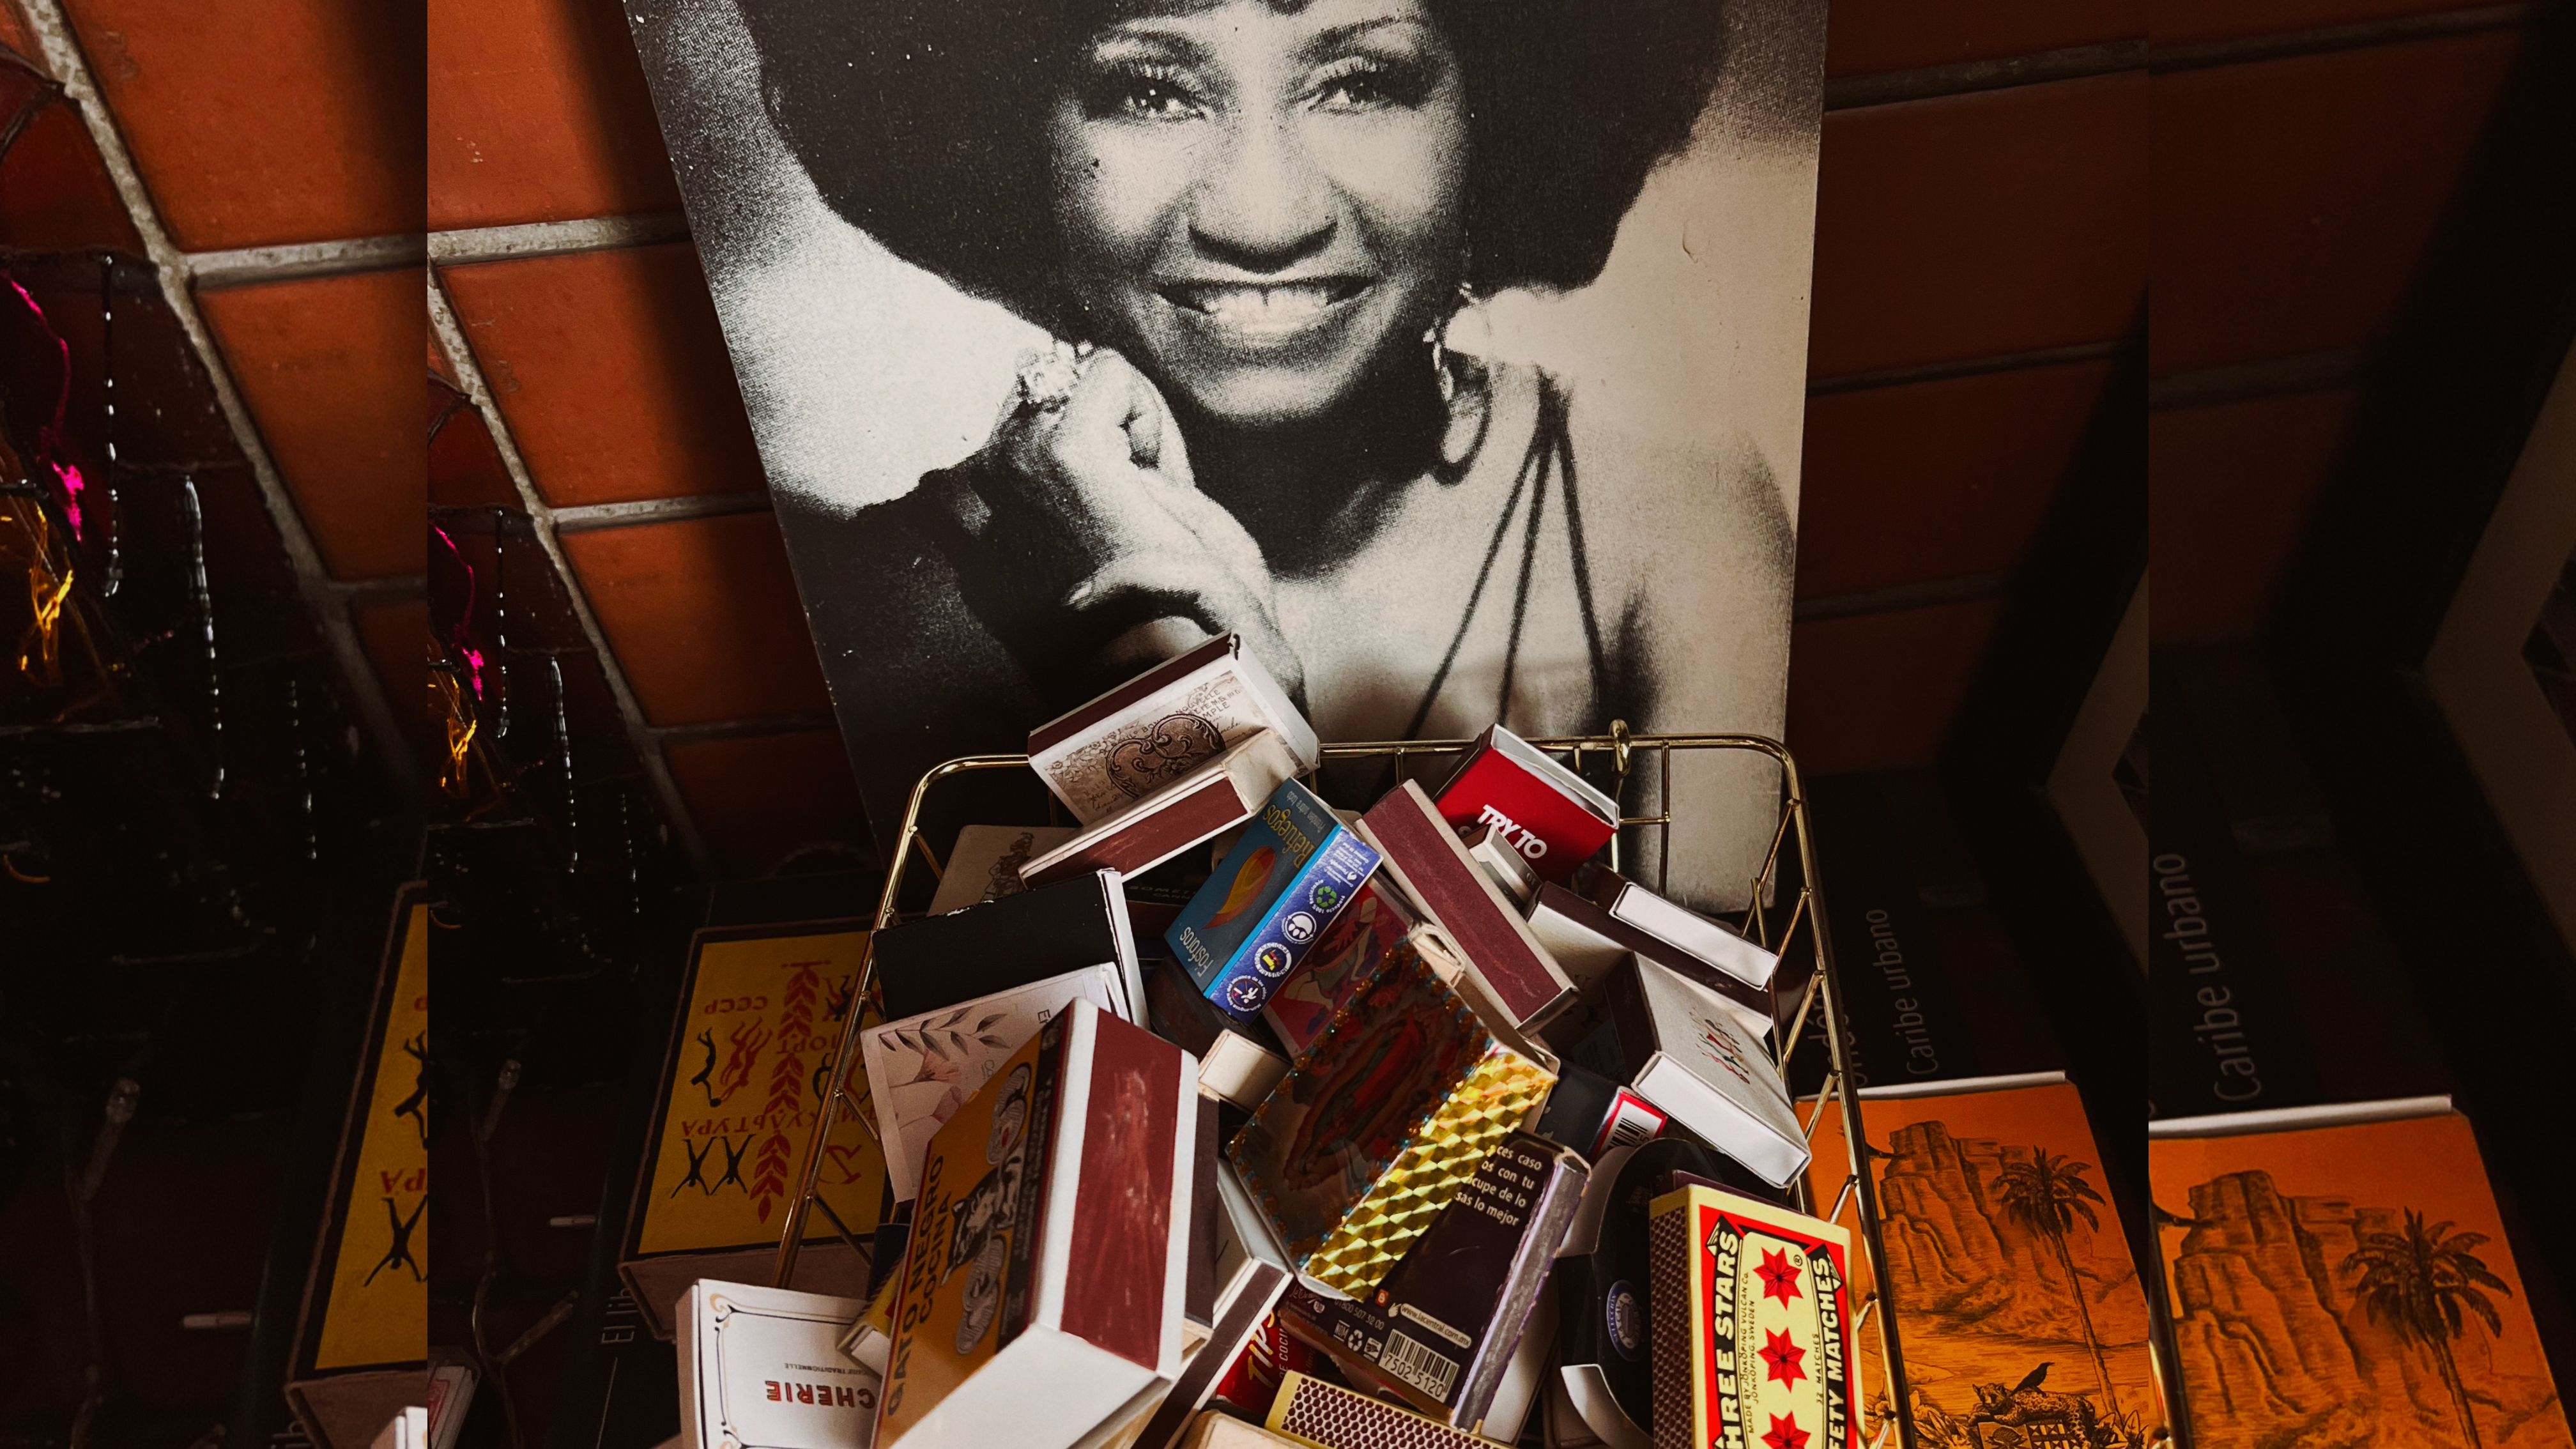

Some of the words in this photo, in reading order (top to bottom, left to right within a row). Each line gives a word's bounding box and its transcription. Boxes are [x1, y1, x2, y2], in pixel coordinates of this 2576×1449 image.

[1175, 689, 1220, 716] NOUVELLE
[1261, 803, 1315, 870] Refuegos
[1476, 803, 1516, 838] TRY
[1516, 829, 1547, 858] TO
[1128, 885, 1197, 895] SOMET
[2152, 851, 2223, 974] urbano
[1177, 926, 1213, 977] Fósforos
[1866, 907, 1913, 990] urbano
[1892, 996, 1939, 1075] Caribe
[2191, 985, 2262, 1101] Caribe
[1497, 1166, 1518, 1183] con
[1521, 1175, 1535, 1190] tu
[1517, 1153, 1544, 1171] caso
[1454, 1190, 1473, 1206] sas
[1473, 1197, 1486, 1212] lo
[1486, 1204, 1519, 1227] mejor
[1498, 1188, 1514, 1202] de
[1514, 1192, 1527, 1209] lo
[919, 1190, 950, 1324] COCINA
[889, 1302, 918, 1415] GATO
[909, 1154, 944, 1294] NEGRO
[1715, 1230, 1738, 1338] STARS
[599, 1325, 636, 1344] El
[1353, 1307, 1367, 1320] 507
[1365, 1314, 1376, 1325] 32
[1374, 1319, 1385, 1331] 00
[1813, 1256, 1843, 1379] MATCHES
[1383, 1353, 1413, 1379] 7502
[1413, 1371, 1445, 1398] 5120
[1812, 1333, 1821, 1383] MATCHES
[765, 1381, 875, 1409] CHERIE
[1744, 1388, 1751, 1399] BY
[1745, 1405, 1754, 1432] MADE
